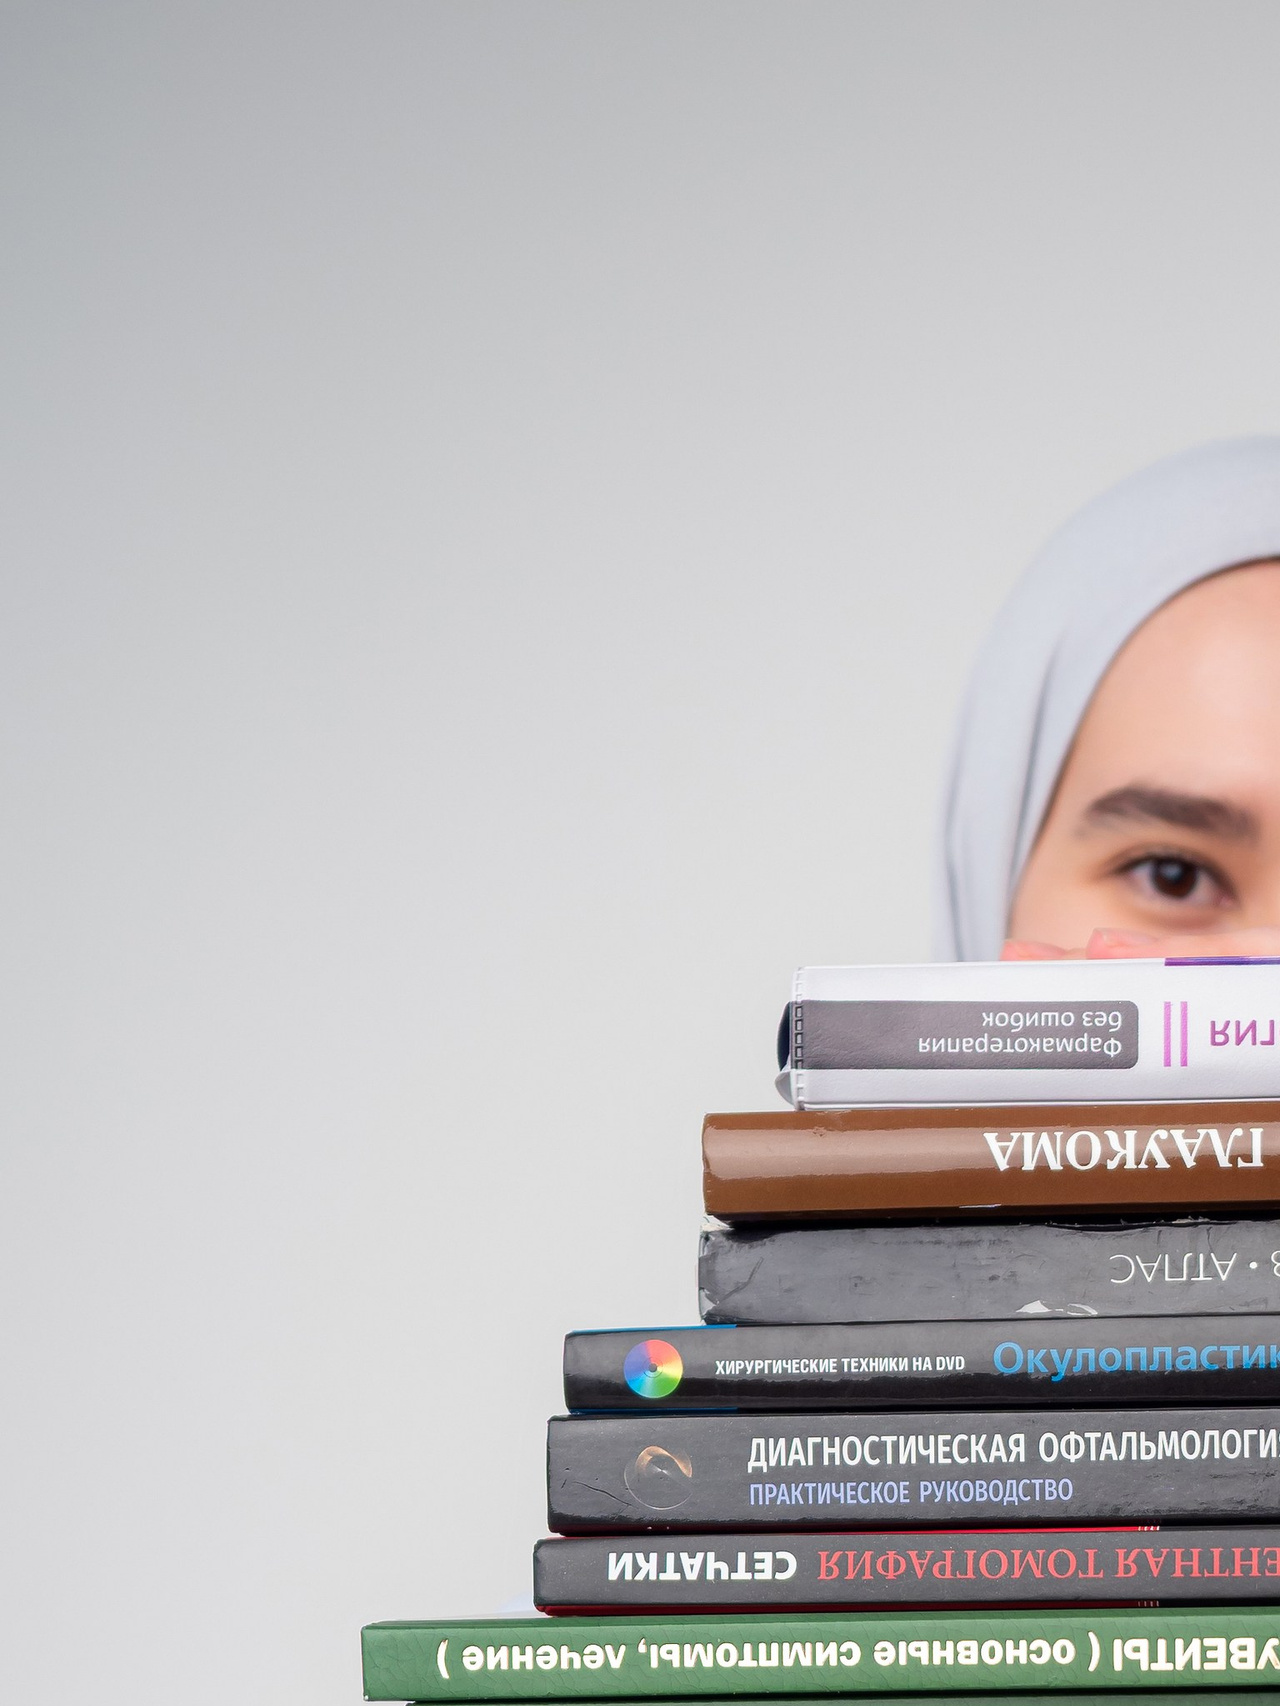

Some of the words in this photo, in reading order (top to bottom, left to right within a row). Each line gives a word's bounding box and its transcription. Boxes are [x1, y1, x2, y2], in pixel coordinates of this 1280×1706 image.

[982, 1012, 1074, 1032] ошибок
[1082, 1011, 1121, 1032] без
[919, 1029, 1121, 1058] Фармакотерапия
[984, 1128, 1263, 1170] ГЛАУКОМА
[1109, 1252, 1238, 1284] АТЛАС
[715, 1359, 837, 1375] ХИРУРГИЧЕСКИЕ
[841, 1357, 909, 1373] ТЕХНИКИ
[912, 1357, 932, 1371] НА
[936, 1356, 966, 1371] DVD
[748, 1434, 1025, 1473] ДИАГНОСТИЧЕСКАЯ
[749, 1480, 910, 1506] ПРАКТИЧЕСКОЕ
[920, 1478, 1073, 1506] РУКОВОДСТВО
[608, 1551, 797, 1581] СЕТЧАТКИ
[818, 1548, 1104, 1580] ТОМОГРАФИЯ
[462, 1644, 626, 1672] лечение
[638, 1639, 862, 1669] симптомы,
[874, 1638, 1076, 1666] основные
